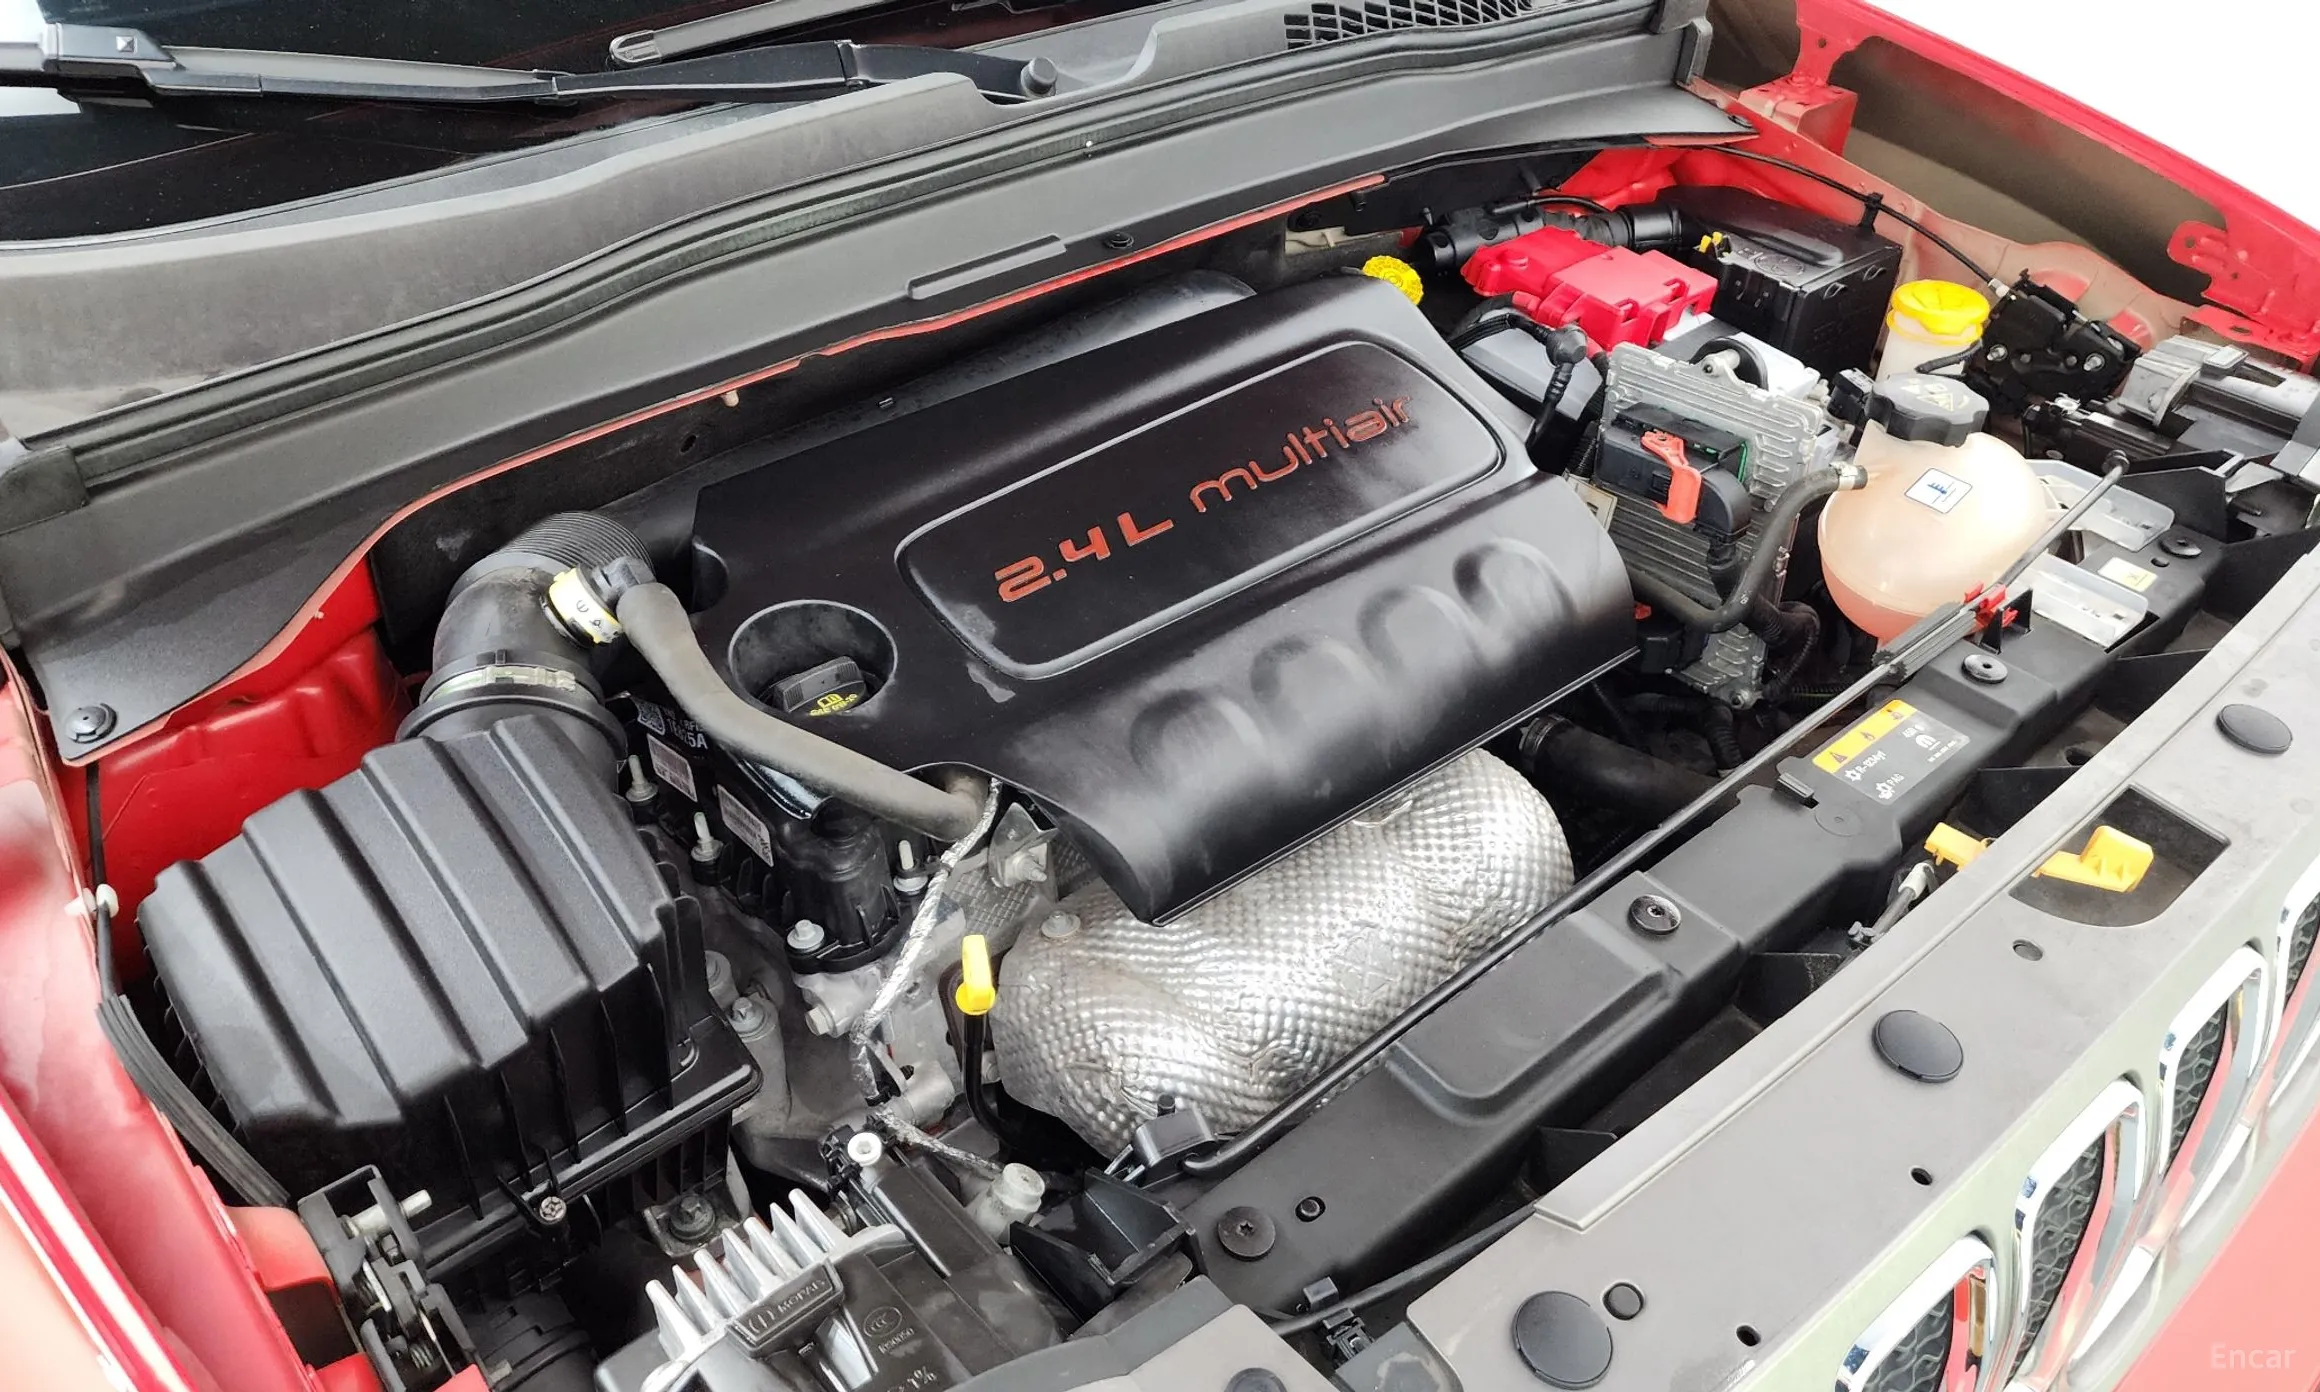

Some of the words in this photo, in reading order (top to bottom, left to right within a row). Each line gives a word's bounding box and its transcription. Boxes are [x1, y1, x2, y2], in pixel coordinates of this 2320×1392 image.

[994, 525, 1111, 603] 2.4
[1116, 512, 1174, 546] L
[1189, 396, 1413, 513] multiair
